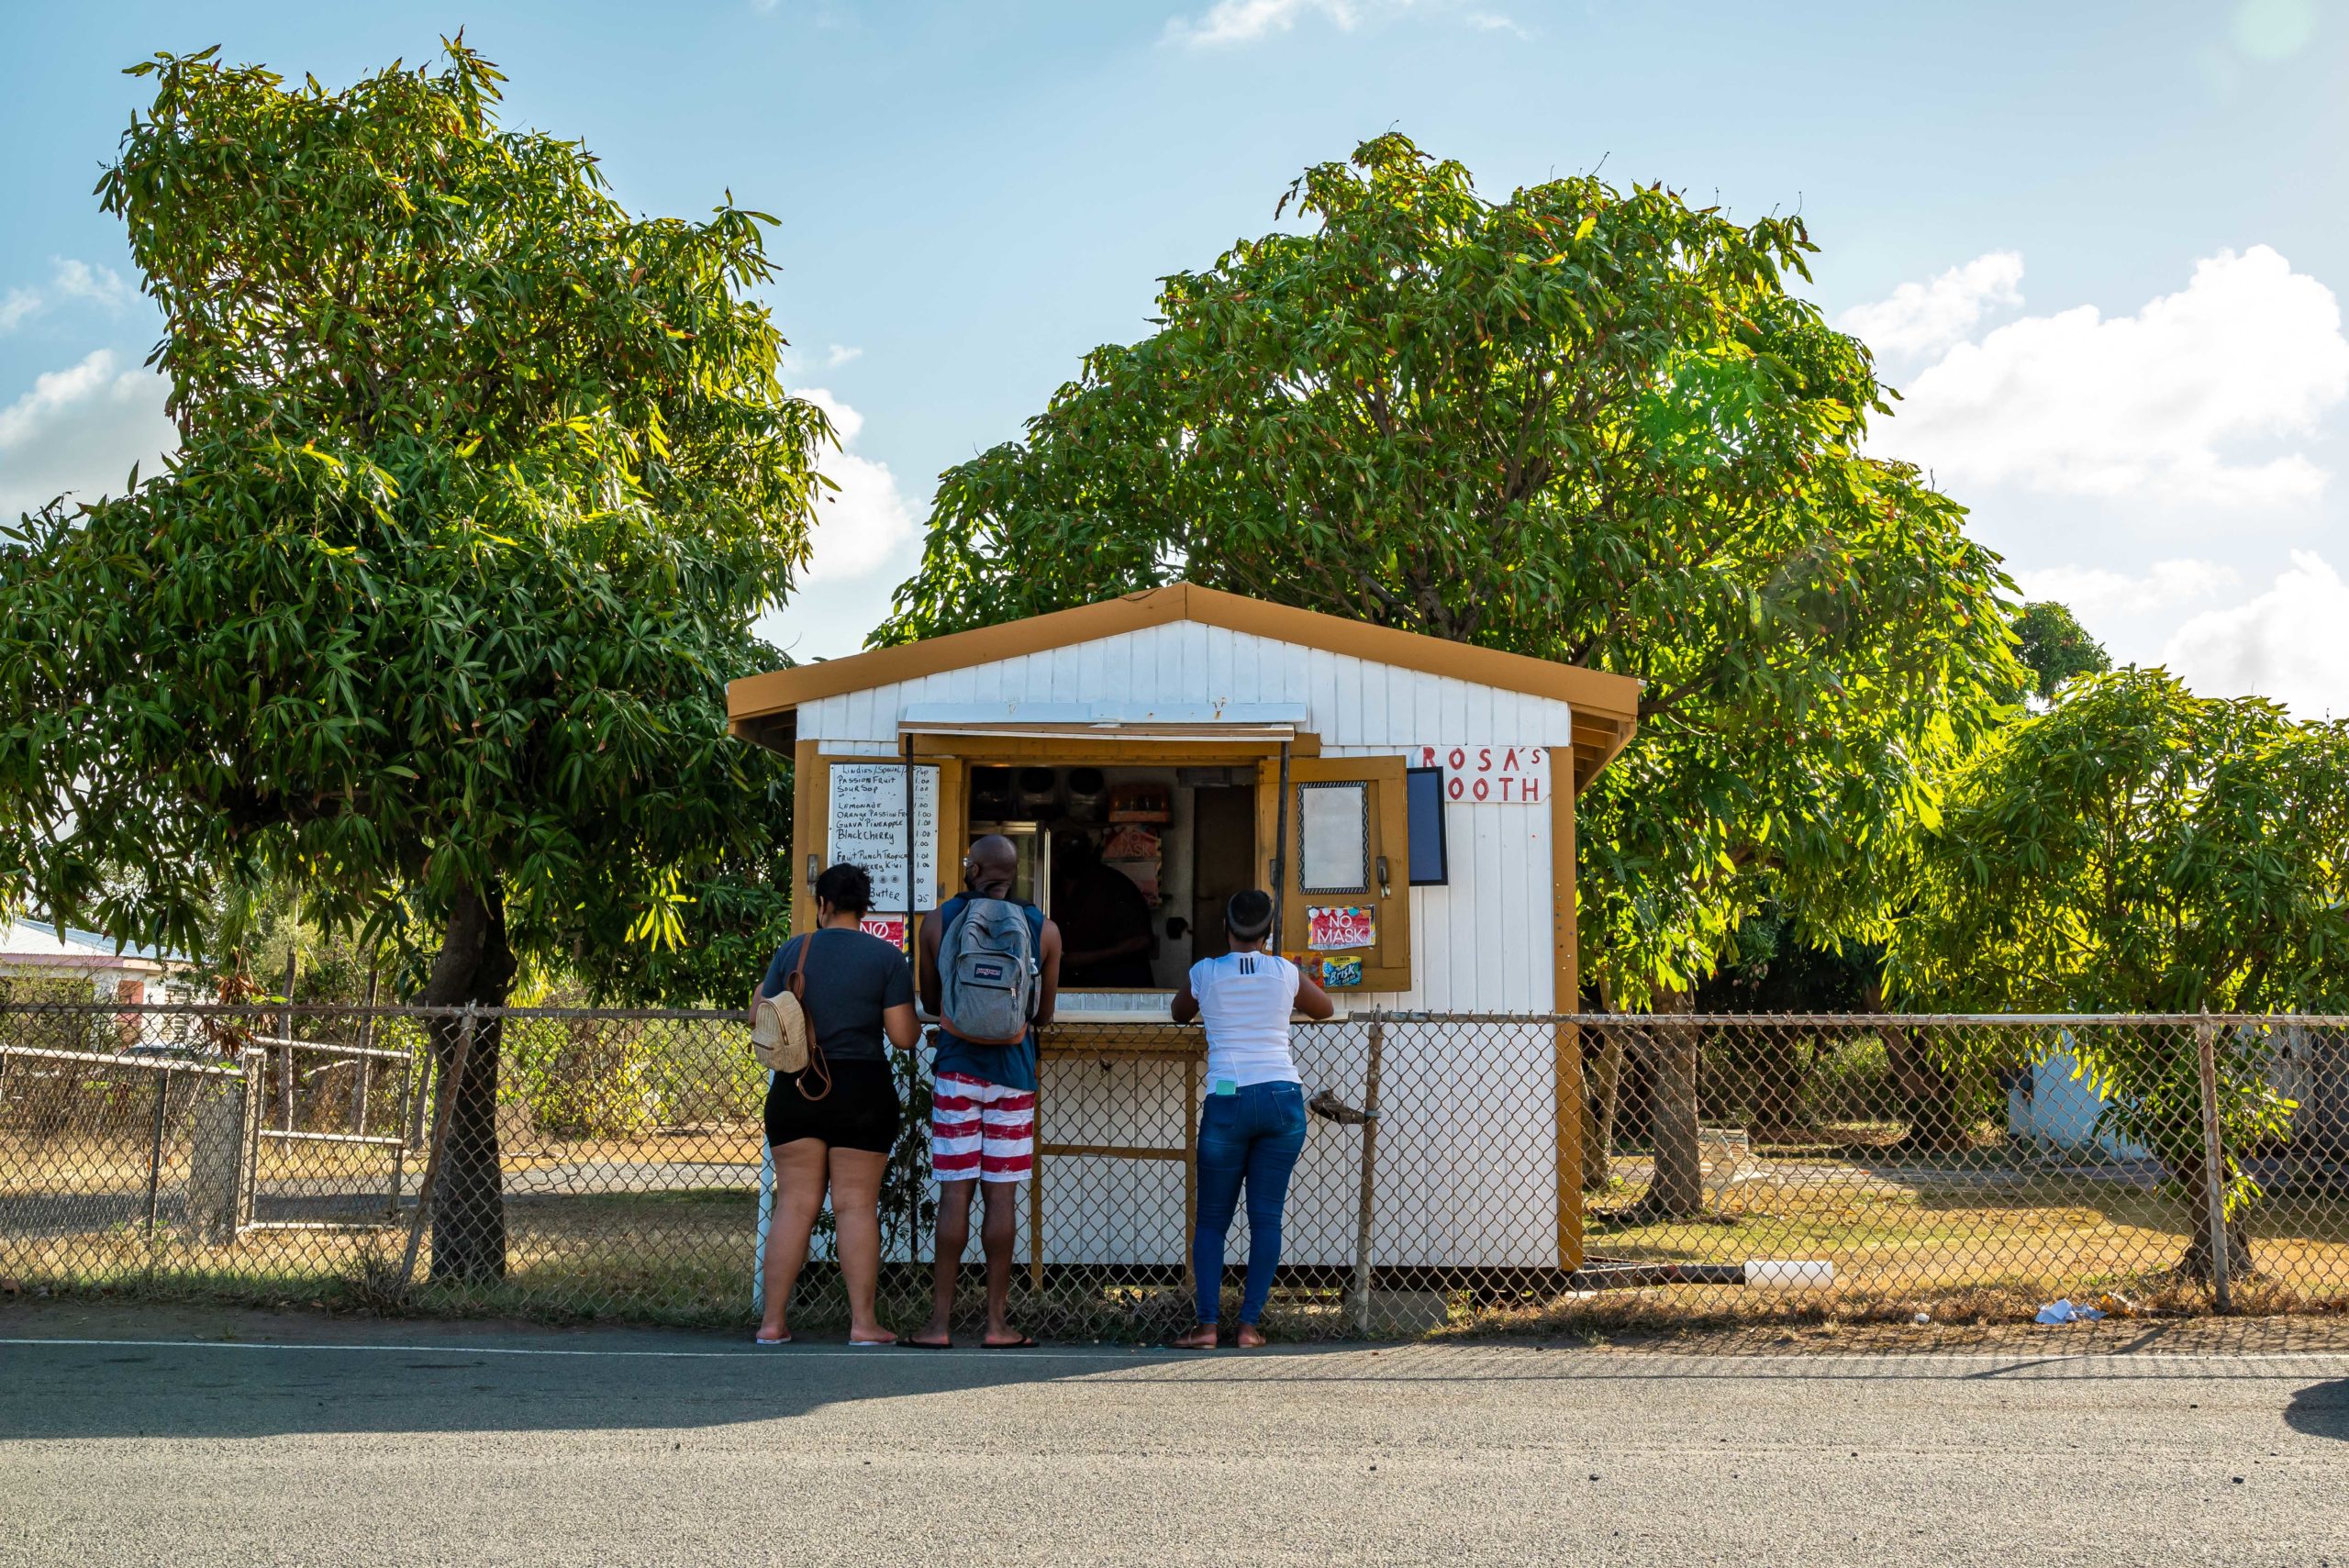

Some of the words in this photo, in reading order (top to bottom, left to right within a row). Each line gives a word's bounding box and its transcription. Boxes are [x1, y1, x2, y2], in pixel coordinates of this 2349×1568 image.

[1423, 747, 1541, 772] ROSA'S
[1448, 777, 1539, 801] OOTH
[1330, 916, 1353, 928] NO
[1317, 928, 1364, 944] MASK
